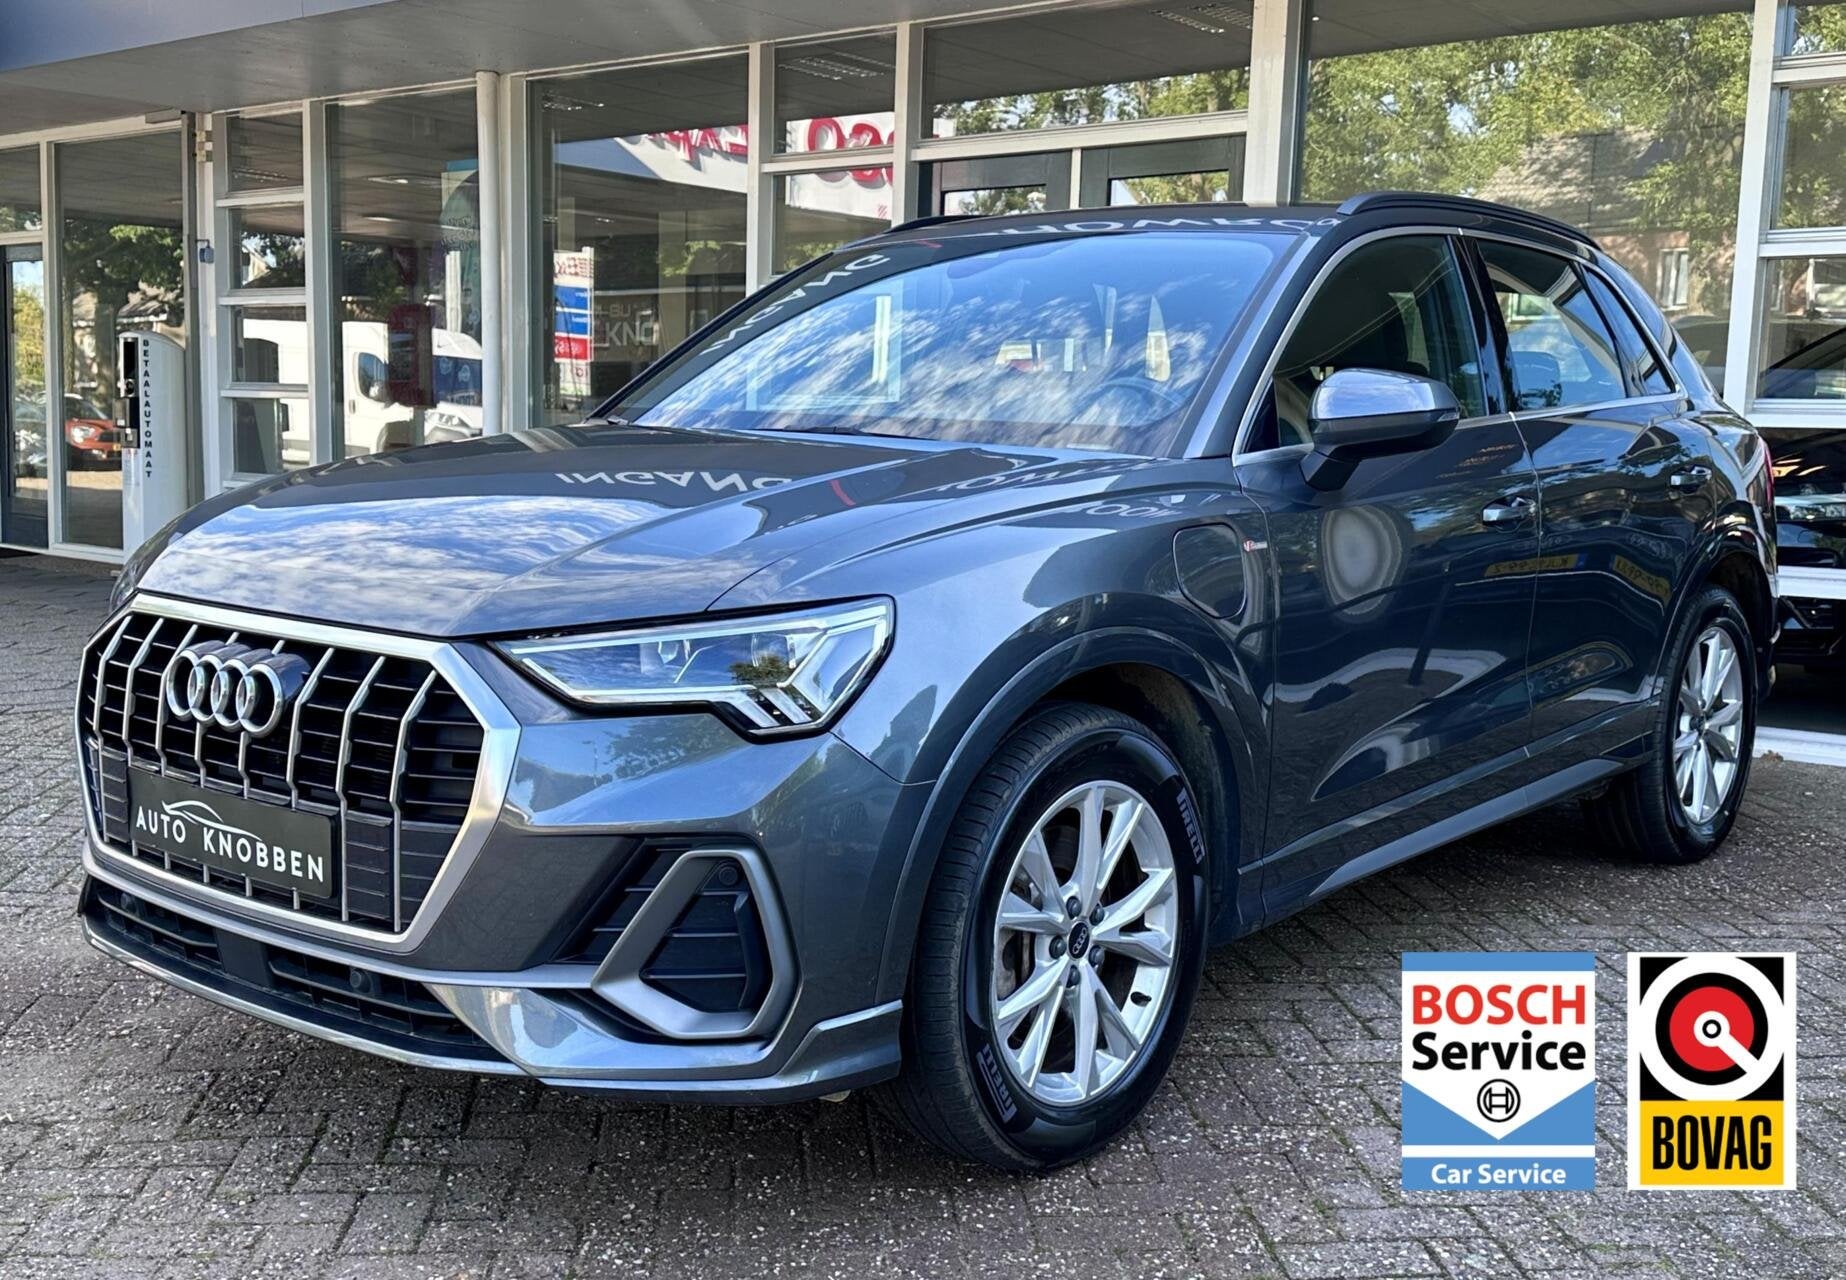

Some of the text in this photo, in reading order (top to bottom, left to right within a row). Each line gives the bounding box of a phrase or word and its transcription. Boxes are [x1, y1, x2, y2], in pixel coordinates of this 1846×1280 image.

[143, 339, 153, 478] BETAALAUTOMAAT
[136, 806, 324, 882] AUTO KNOBBEN
[1176, 787, 1205, 864] PIRELLI
[976, 1043, 1017, 1124] PIRELLI
